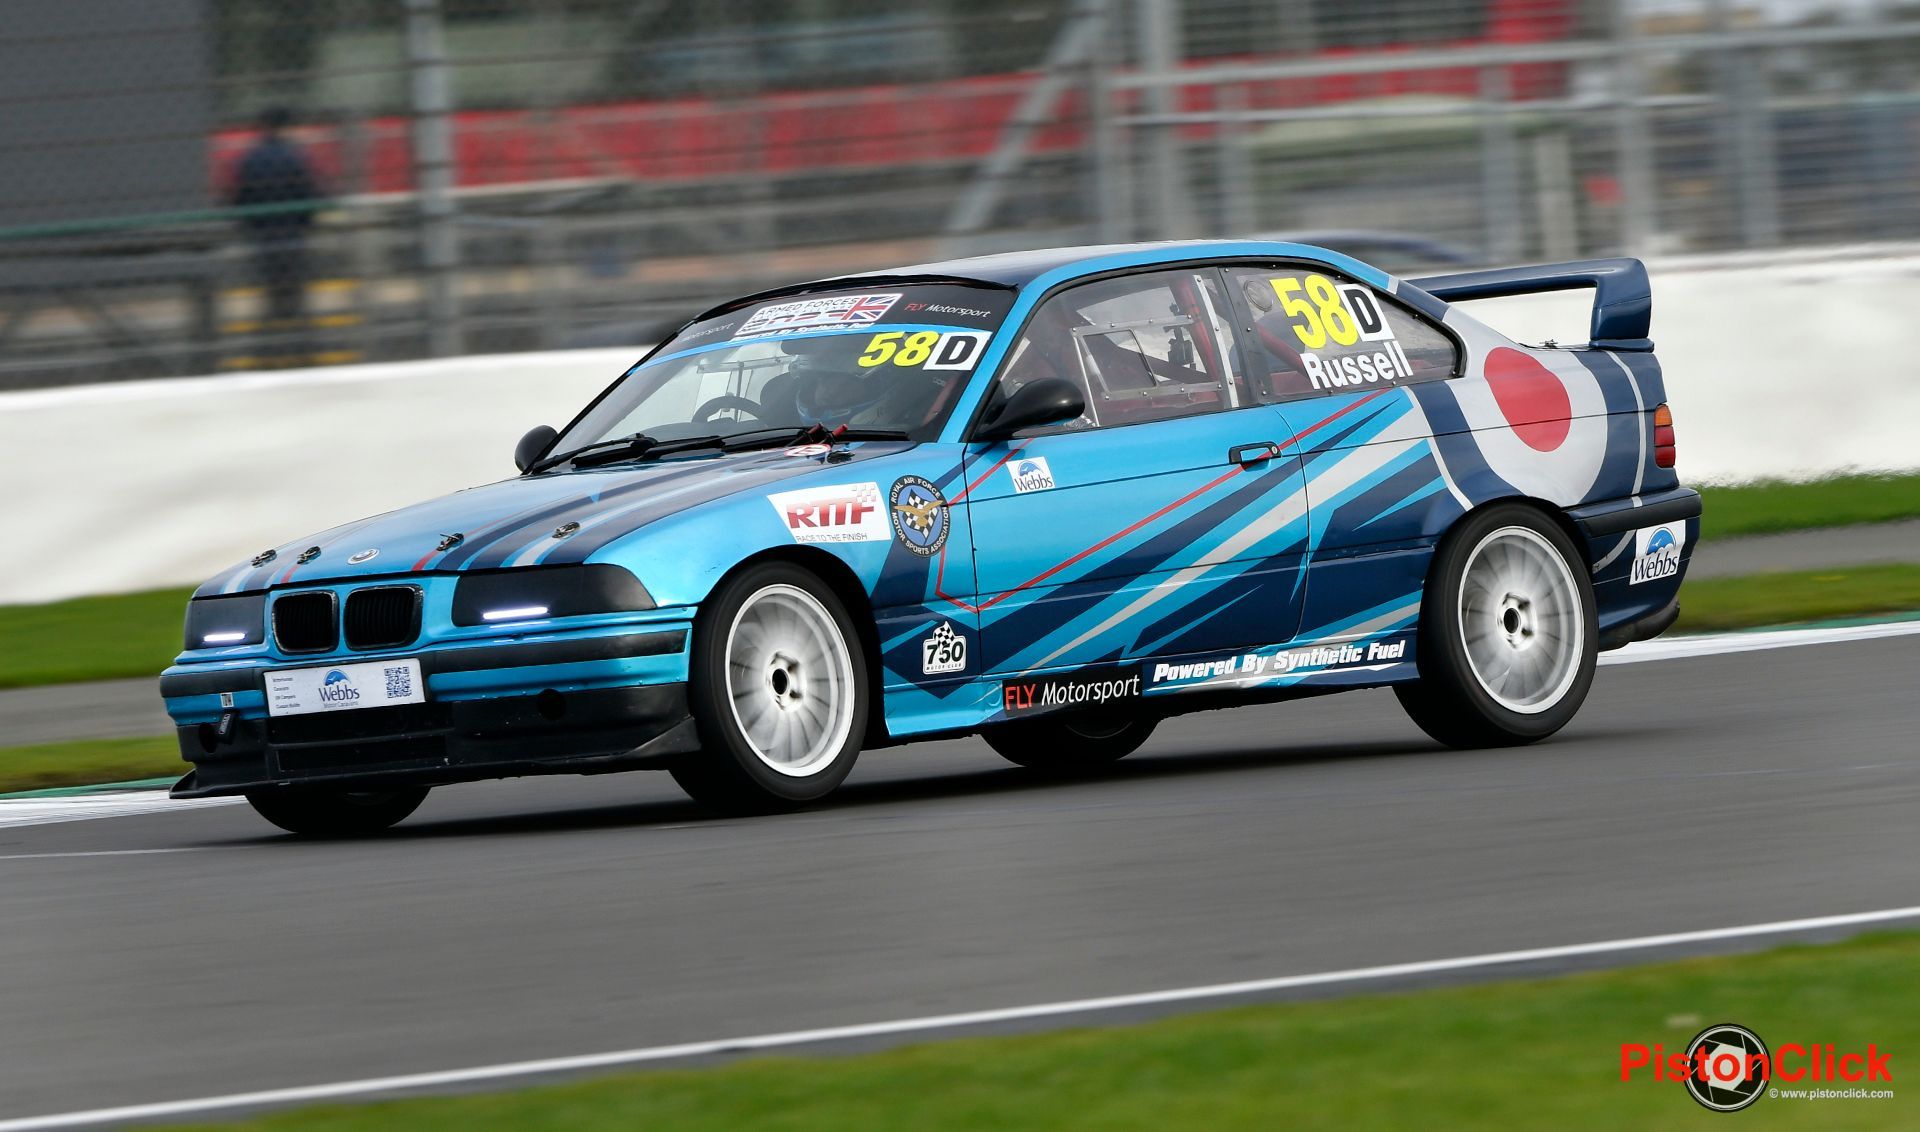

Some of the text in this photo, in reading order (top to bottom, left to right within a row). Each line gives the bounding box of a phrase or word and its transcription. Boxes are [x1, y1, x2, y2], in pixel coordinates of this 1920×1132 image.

[757, 303, 803, 316] ARMED
[805, 297, 860, 309] FORCES
[904, 303, 991, 318] FLY Motorsport
[1269, 274, 1383, 348] 58 D
[857, 330, 978, 367] 58 D
[1300, 340, 1414, 390] Russell
[890, 477, 941, 503] ROYAL AIR FORCE
[1014, 473, 1053, 491] Webbs
[796, 532, 868, 542] RACE TO THE FINISH
[892, 506, 949, 555] MOTOR SPORTS ASSOCIATION
[1634, 551, 1678, 581] Webbs
[926, 641, 964, 665] 750
[1153, 639, 1406, 683] Powered By Synthetic Fuel
[318, 684, 360, 702] Webbs
[1004, 674, 1140, 711] FLY Motorsport
